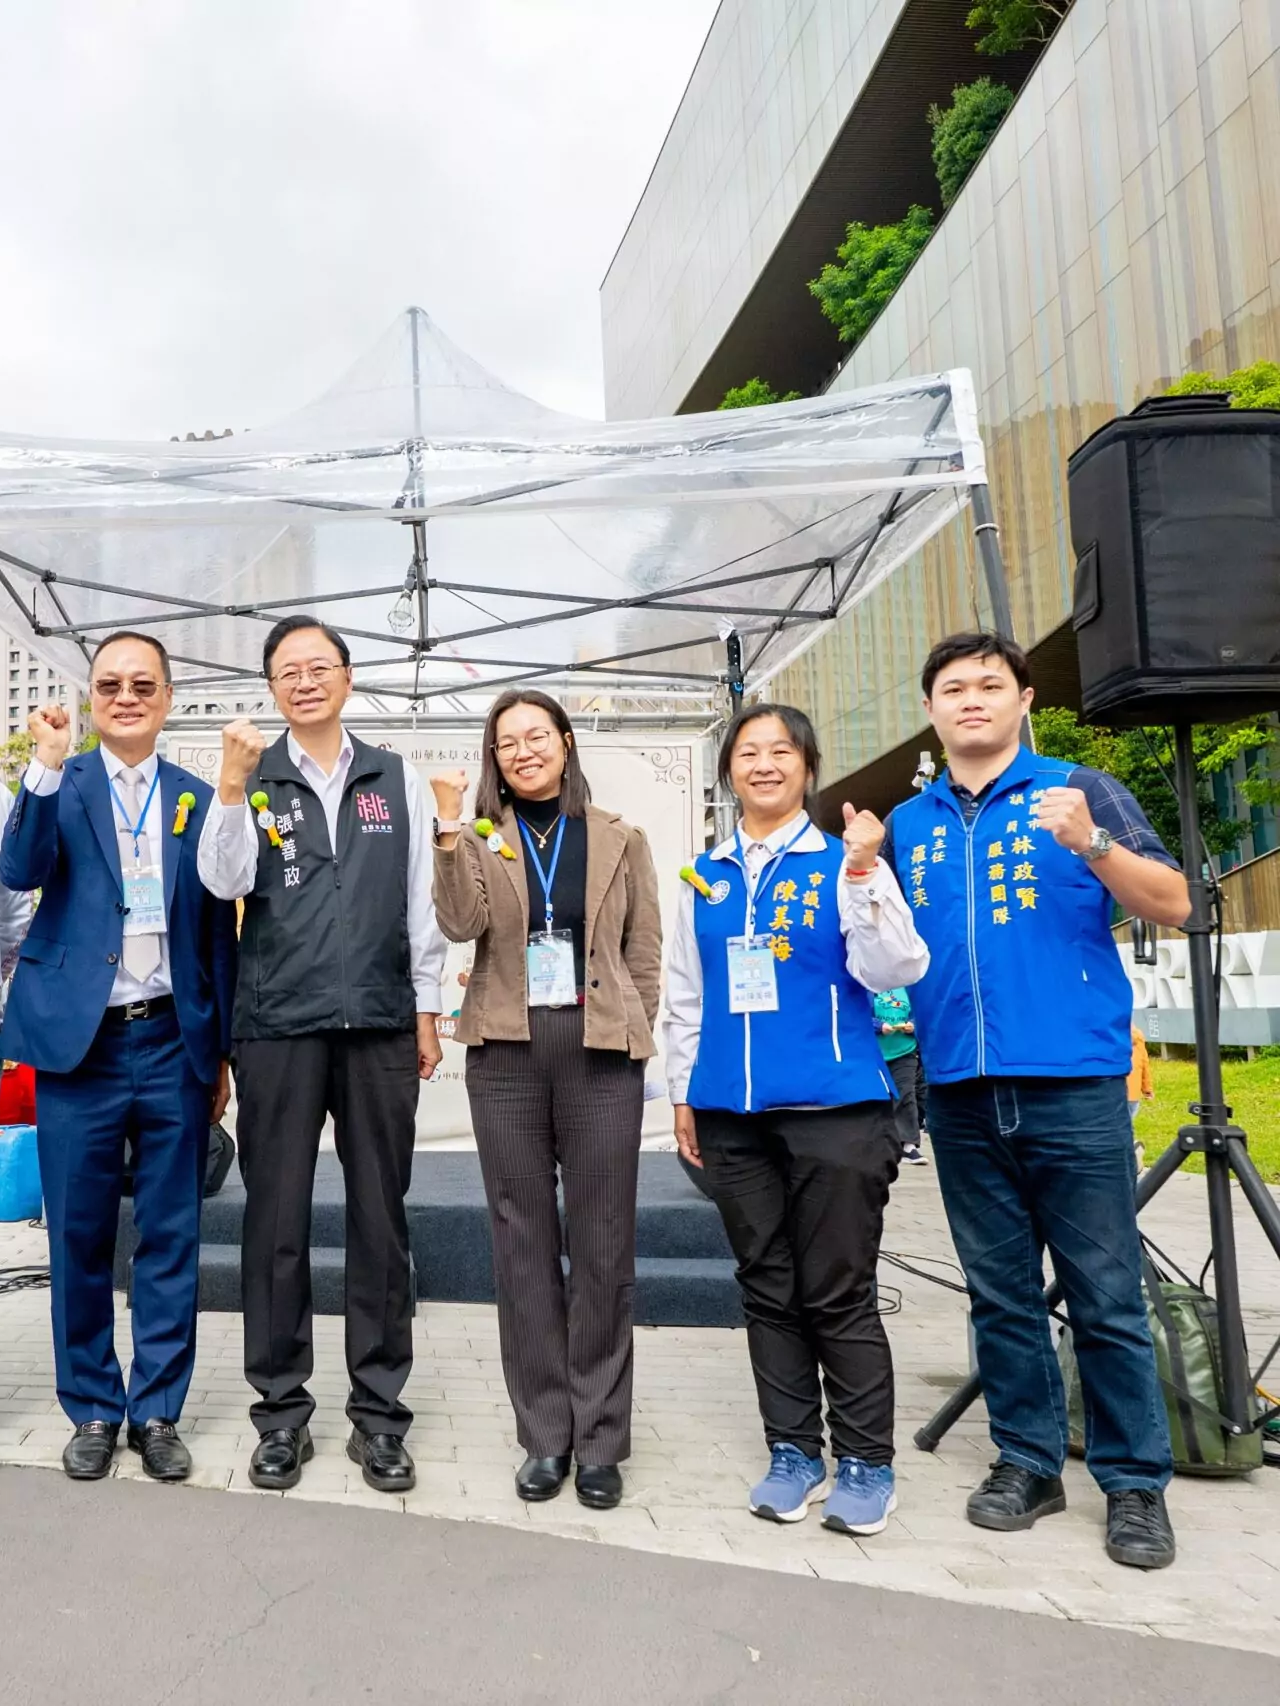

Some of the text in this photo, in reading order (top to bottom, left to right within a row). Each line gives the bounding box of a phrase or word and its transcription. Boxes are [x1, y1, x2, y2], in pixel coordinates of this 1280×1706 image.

[291, 797, 304, 822] 市長
[276, 813, 301, 888] 張善政
[987, 841, 1012, 925] 服務團隊
[1011, 835, 1040, 910] 林政賢
[767, 879, 799, 962] 陳美梅
[802, 871, 825, 929] 市議員
